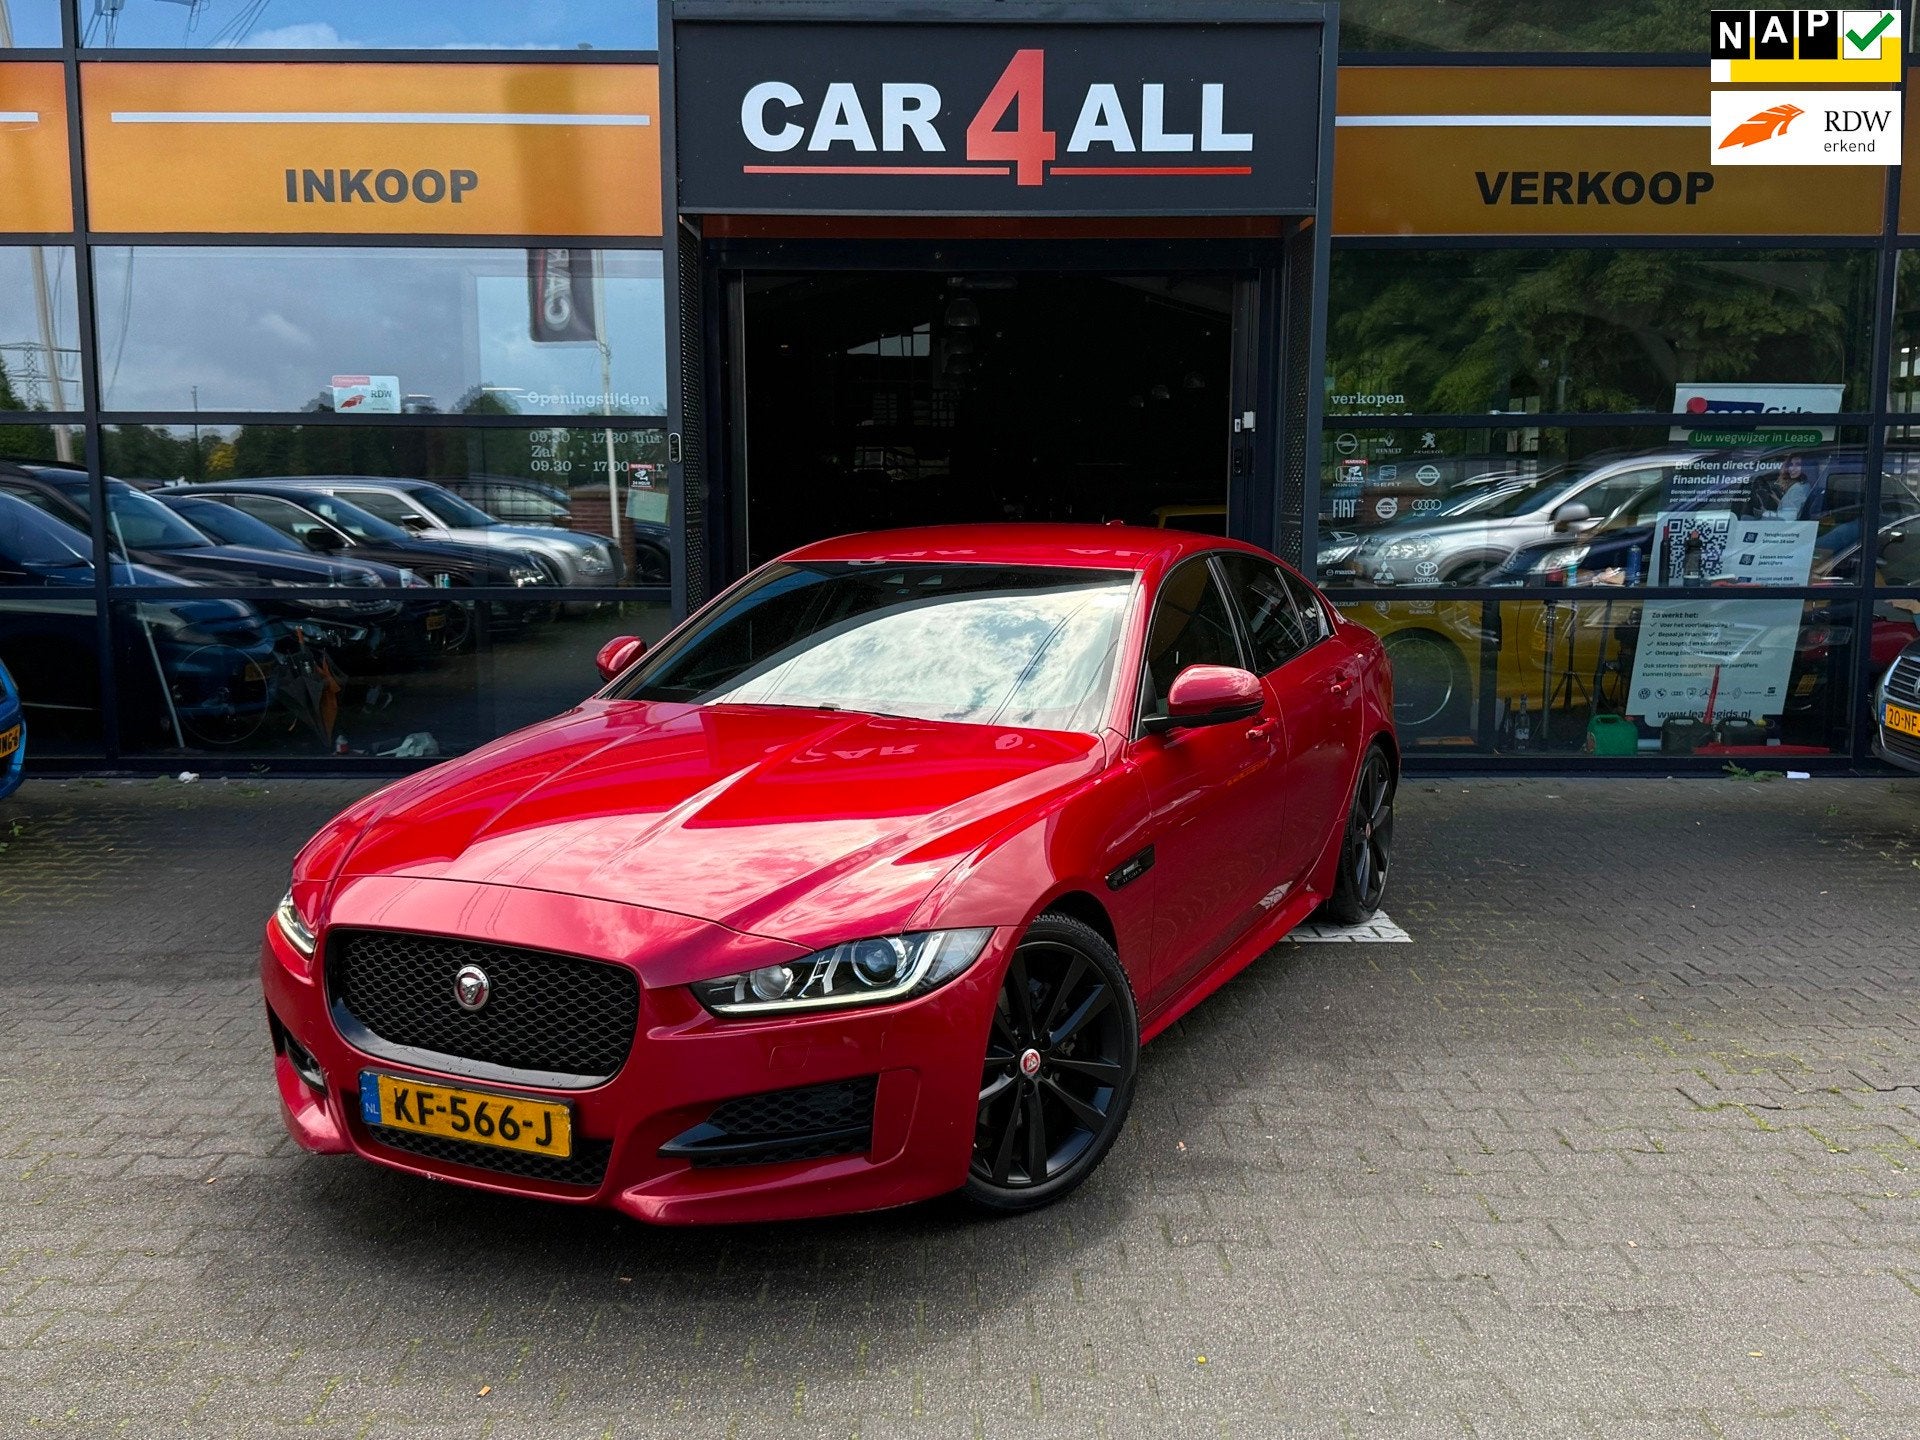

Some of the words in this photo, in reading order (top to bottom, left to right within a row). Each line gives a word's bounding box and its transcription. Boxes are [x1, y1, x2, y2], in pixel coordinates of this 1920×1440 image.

[741, 81, 946, 152] CAR
[966, 48, 1056, 186] 4
[1066, 83, 1253, 153] ALL
[285, 168, 478, 203] INKOOP
[1474, 171, 1715, 205] VERKOOP
[371, 390, 392, 398] RDW
[528, 391, 650, 407] Openingstijden
[1331, 392, 1405, 407] verkopen
[591, 432, 628, 443] 1730
[1695, 433, 1712, 442] Uw
[1715, 433, 1769, 445] wegwijzer
[1772, 433, 1782, 442] in
[1785, 433, 1816, 442] Lease
[531, 461, 572, 472] 09.30
[1675, 461, 1721, 470] Bereken
[1722, 461, 1754, 470] direct
[1755, 461, 1783, 472] jouw
[1673, 475, 1719, 484] financial
[1721, 475, 1751, 484] lease
[1332, 499, 1357, 518] FIAT
[1657, 710, 1752, 719] www.leaegids.nl
[1889, 708, 1920, 733] 20-NF
[366, 1102, 379, 1115] NL
[393, 1087, 553, 1147] KF-566-J
